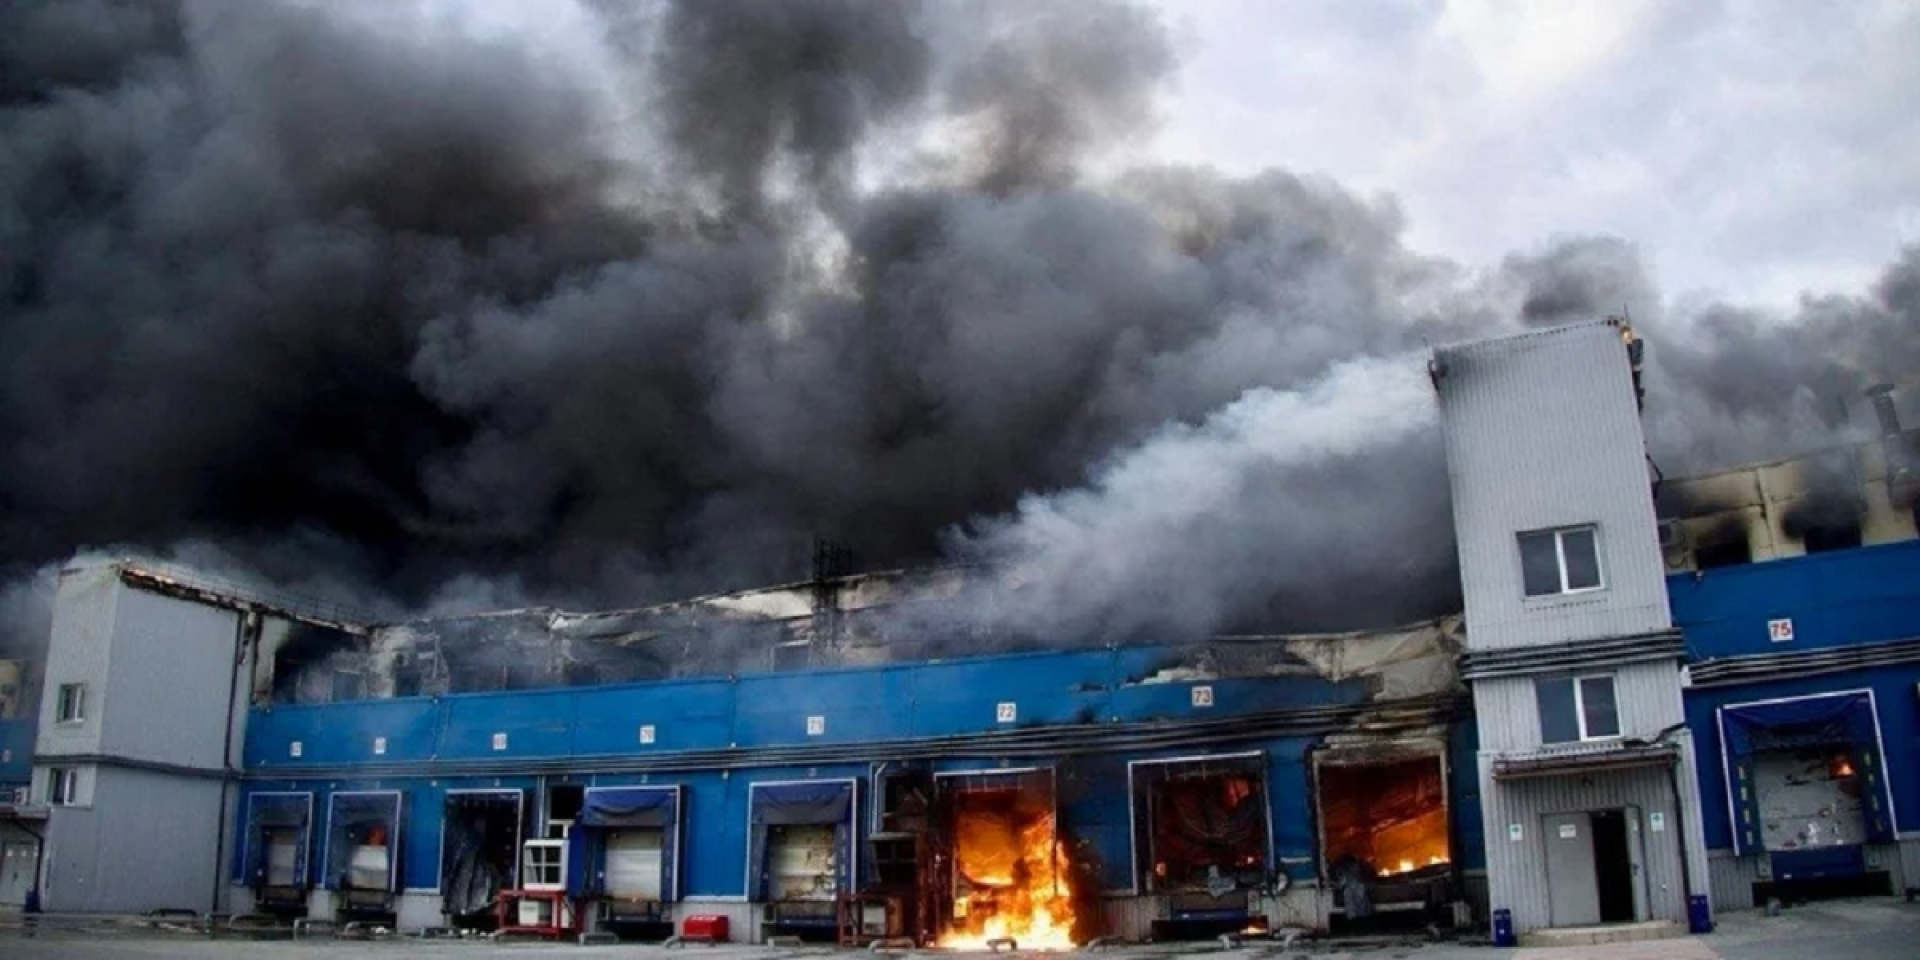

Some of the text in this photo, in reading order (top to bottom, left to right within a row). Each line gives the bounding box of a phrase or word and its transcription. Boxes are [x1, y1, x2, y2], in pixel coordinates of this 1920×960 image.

[1770, 621, 1791, 637] 75
[1194, 689, 1210, 703] 73
[1000, 705, 1013, 718] 72
